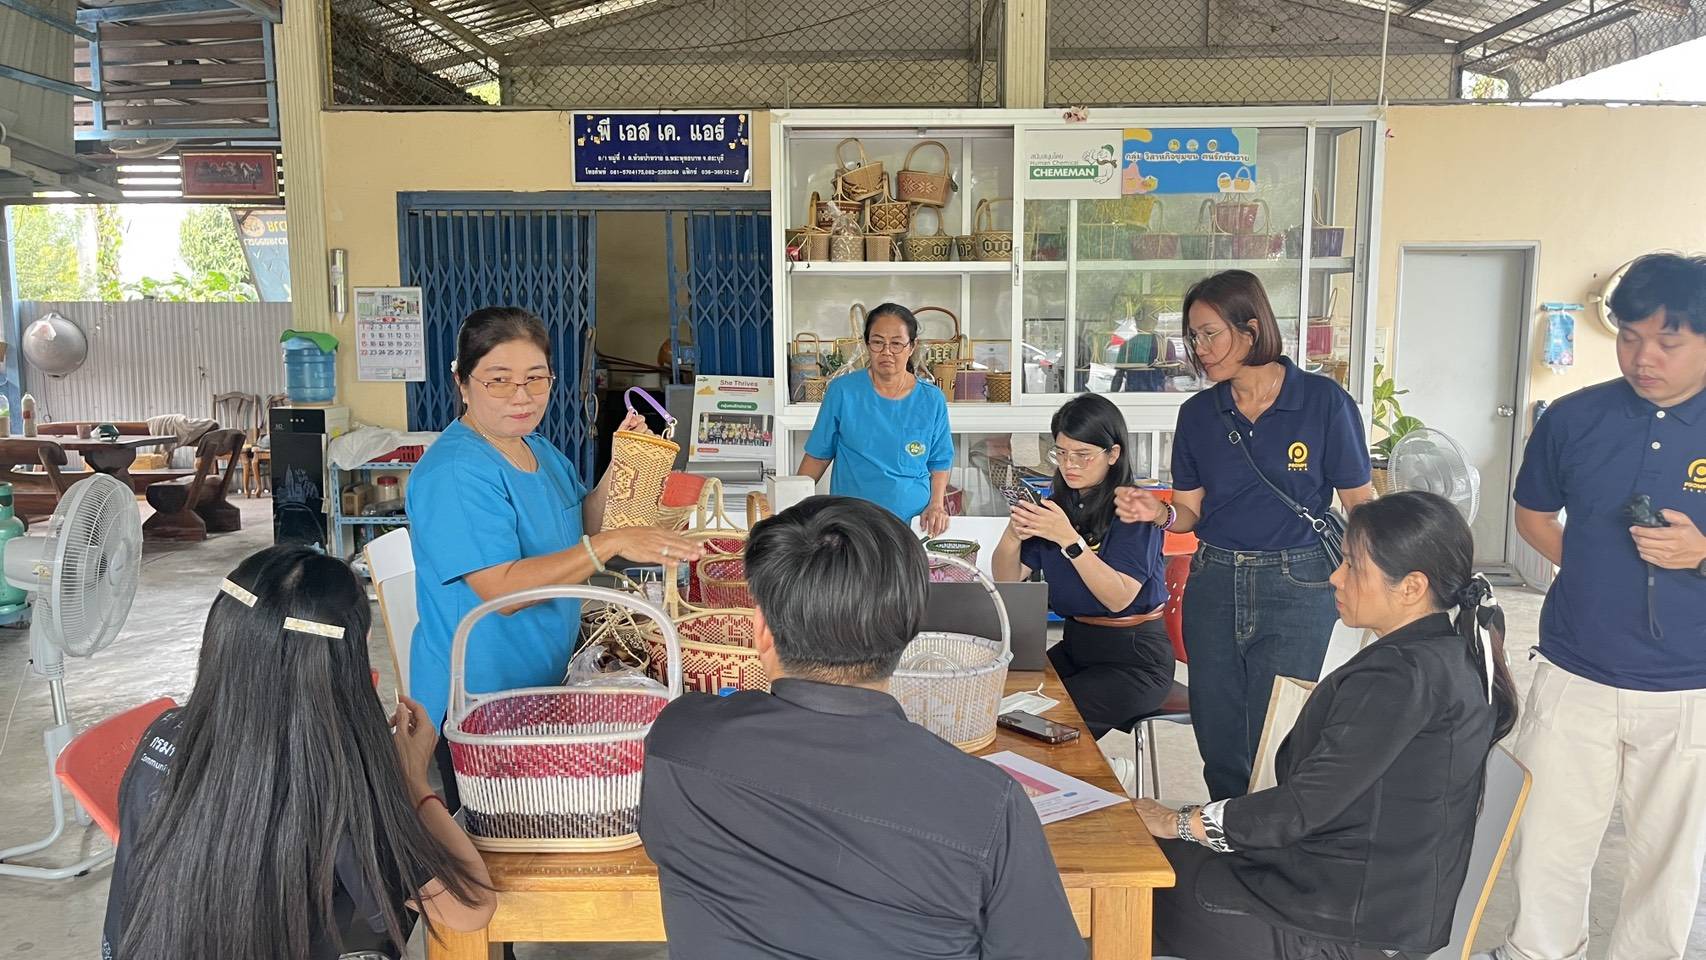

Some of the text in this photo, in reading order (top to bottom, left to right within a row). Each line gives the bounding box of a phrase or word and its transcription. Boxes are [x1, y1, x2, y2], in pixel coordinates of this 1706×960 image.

[597, 117, 725, 142] พี เอส เค. แอร์
[1033, 168, 1095, 177] CHEMEMAN
